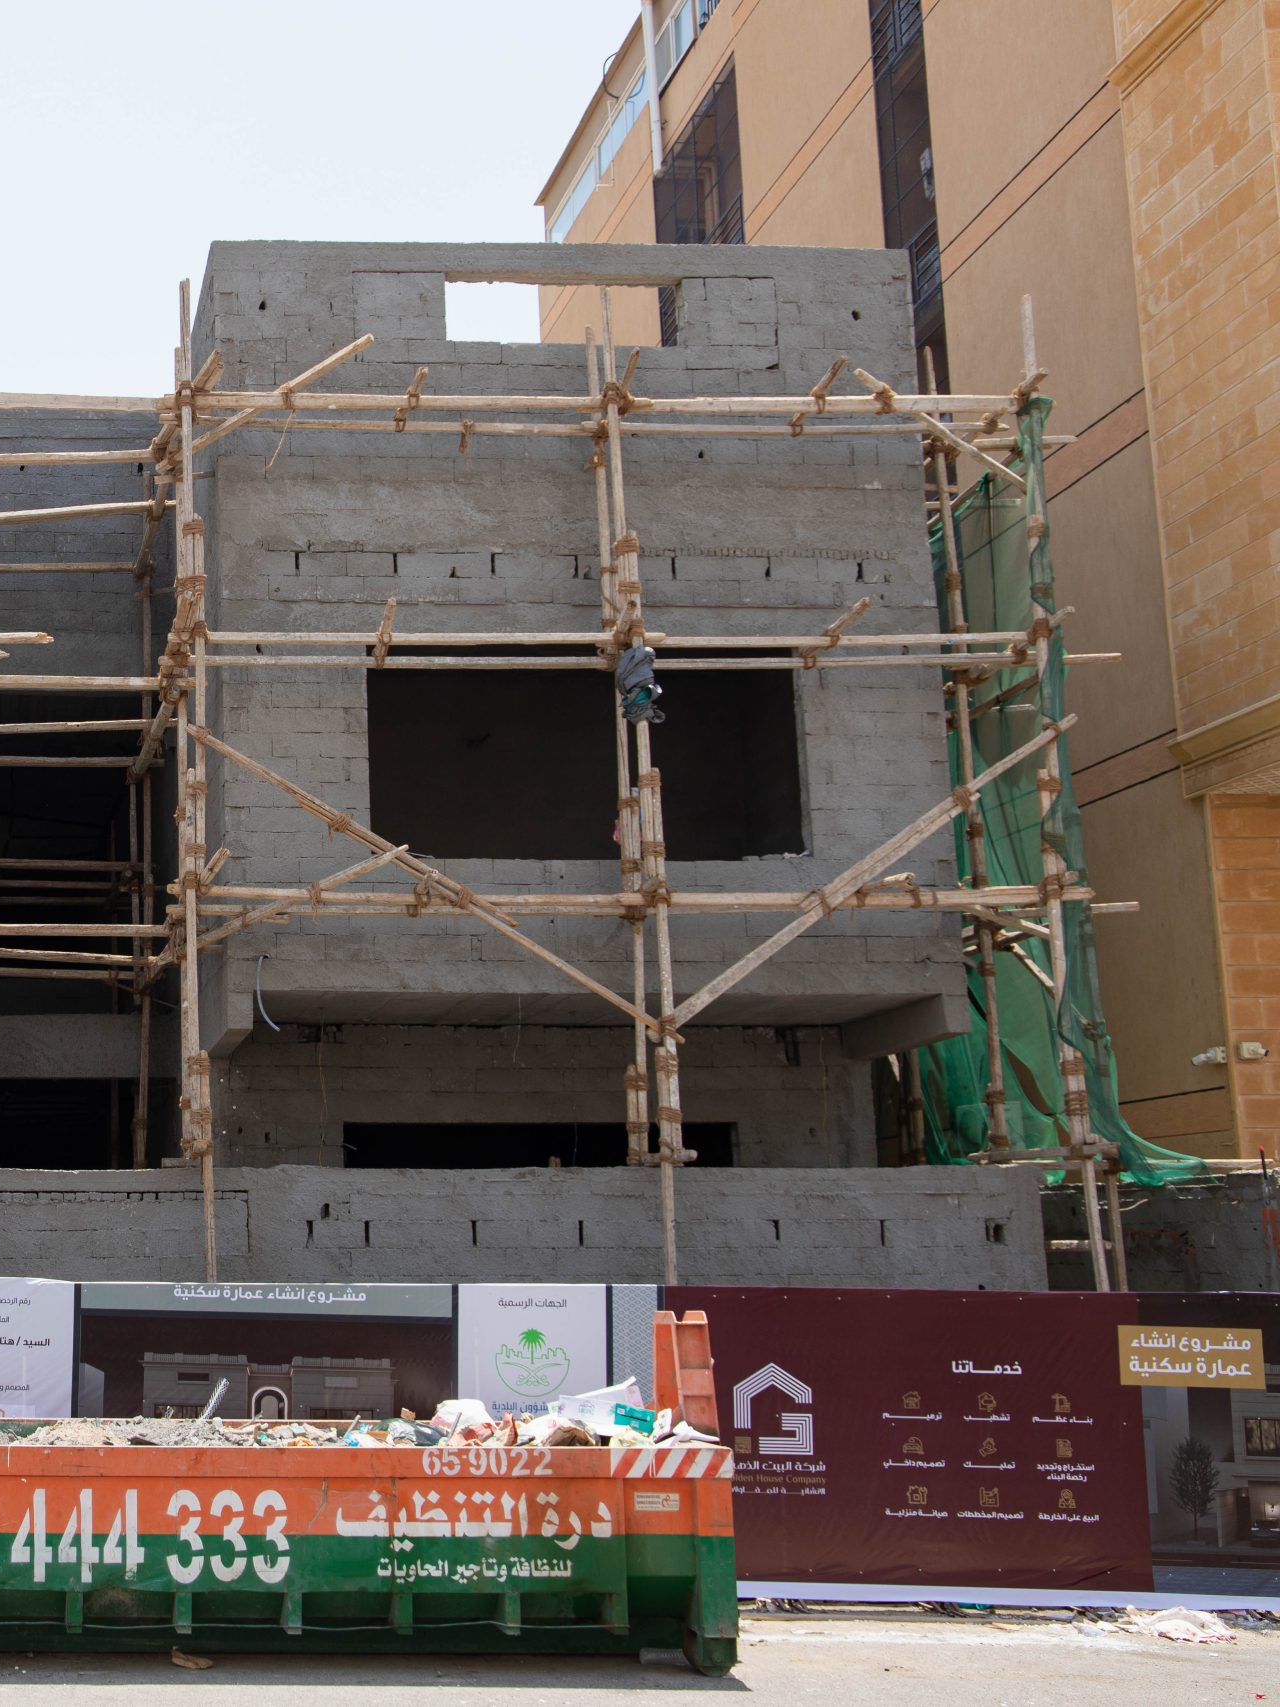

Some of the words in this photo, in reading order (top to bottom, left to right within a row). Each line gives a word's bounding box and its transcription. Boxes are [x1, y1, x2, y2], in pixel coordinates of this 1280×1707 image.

[173, 1284, 221, 1300] سكنية
[222, 1286, 263, 1301] عمارة
[267, 1286, 305, 1300] انشاء
[307, 1287, 367, 1303] مشروع
[498, 1298, 533, 1309] الرسمية
[535, 1299, 567, 1310] الجهات
[23, 1338, 50, 1348] السيد
[1130, 1331, 1176, 1348] انشاء
[1178, 1333, 1252, 1353] مشروع
[1129, 1355, 1192, 1377] سكنية
[1196, 1357, 1252, 1378] عمارة
[491, 1401, 518, 1413] البلدية
[762, 1461, 792, 1473] البيت
[794, 1461, 826, 1473] شركة
[733, 1474, 754, 1483] lden
[757, 1474, 783, 1483] House
[786, 1474, 826, 1486] Company
[336, 1490, 529, 1552] التنظيف
[535, 1491, 613, 1551] درة
[11, 1488, 145, 1583] 444
[166, 1489, 291, 1584] 333
[376, 1557, 449, 1584] الحاويات
[451, 1557, 508, 1584] وتأجير
[509, 1556, 572, 1577] للنظافة
